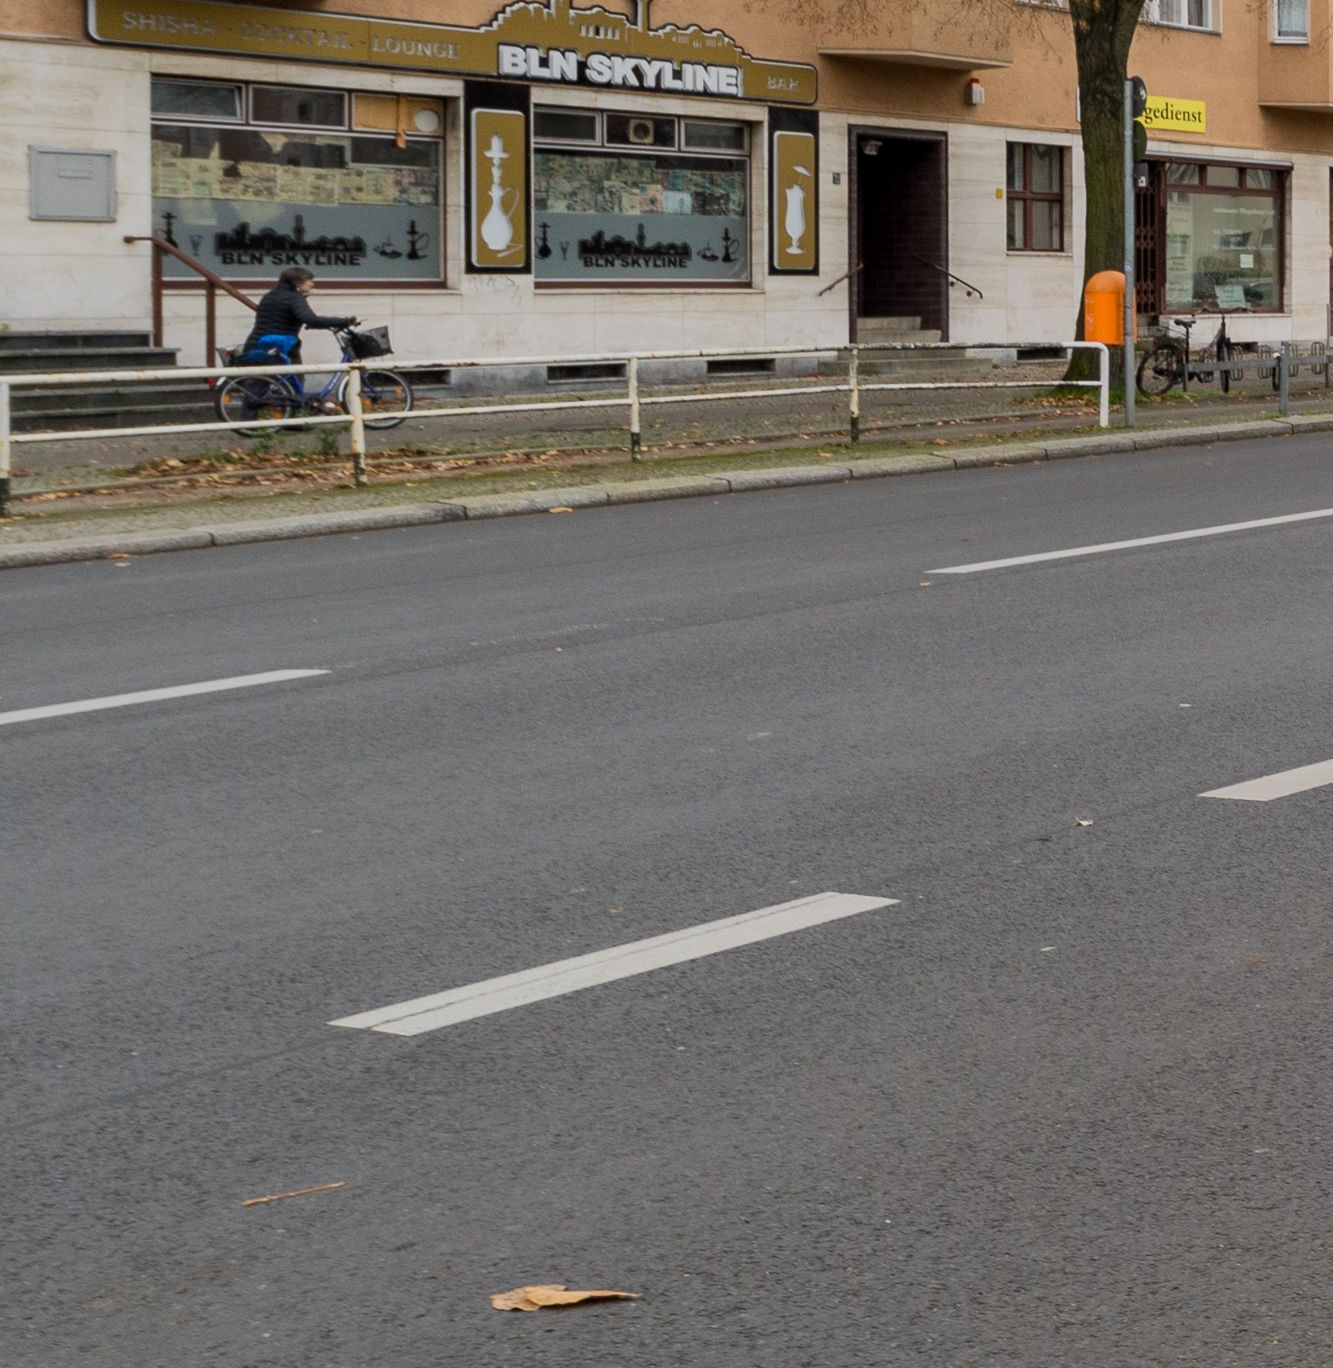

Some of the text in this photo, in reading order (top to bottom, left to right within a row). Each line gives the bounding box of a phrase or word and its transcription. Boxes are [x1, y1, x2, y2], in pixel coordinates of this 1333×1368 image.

[121, 11, 460, 60] SHISHA COCKTAIL LOUNGE
[499, 43, 743, 97] BLN SKYLINE
[766, 74, 800, 91] BAR
[1144, 102, 1203, 125] gedienst
[221, 251, 361, 267] BLN SKYLINE
[583, 256, 688, 269] BLN SKYLINE
